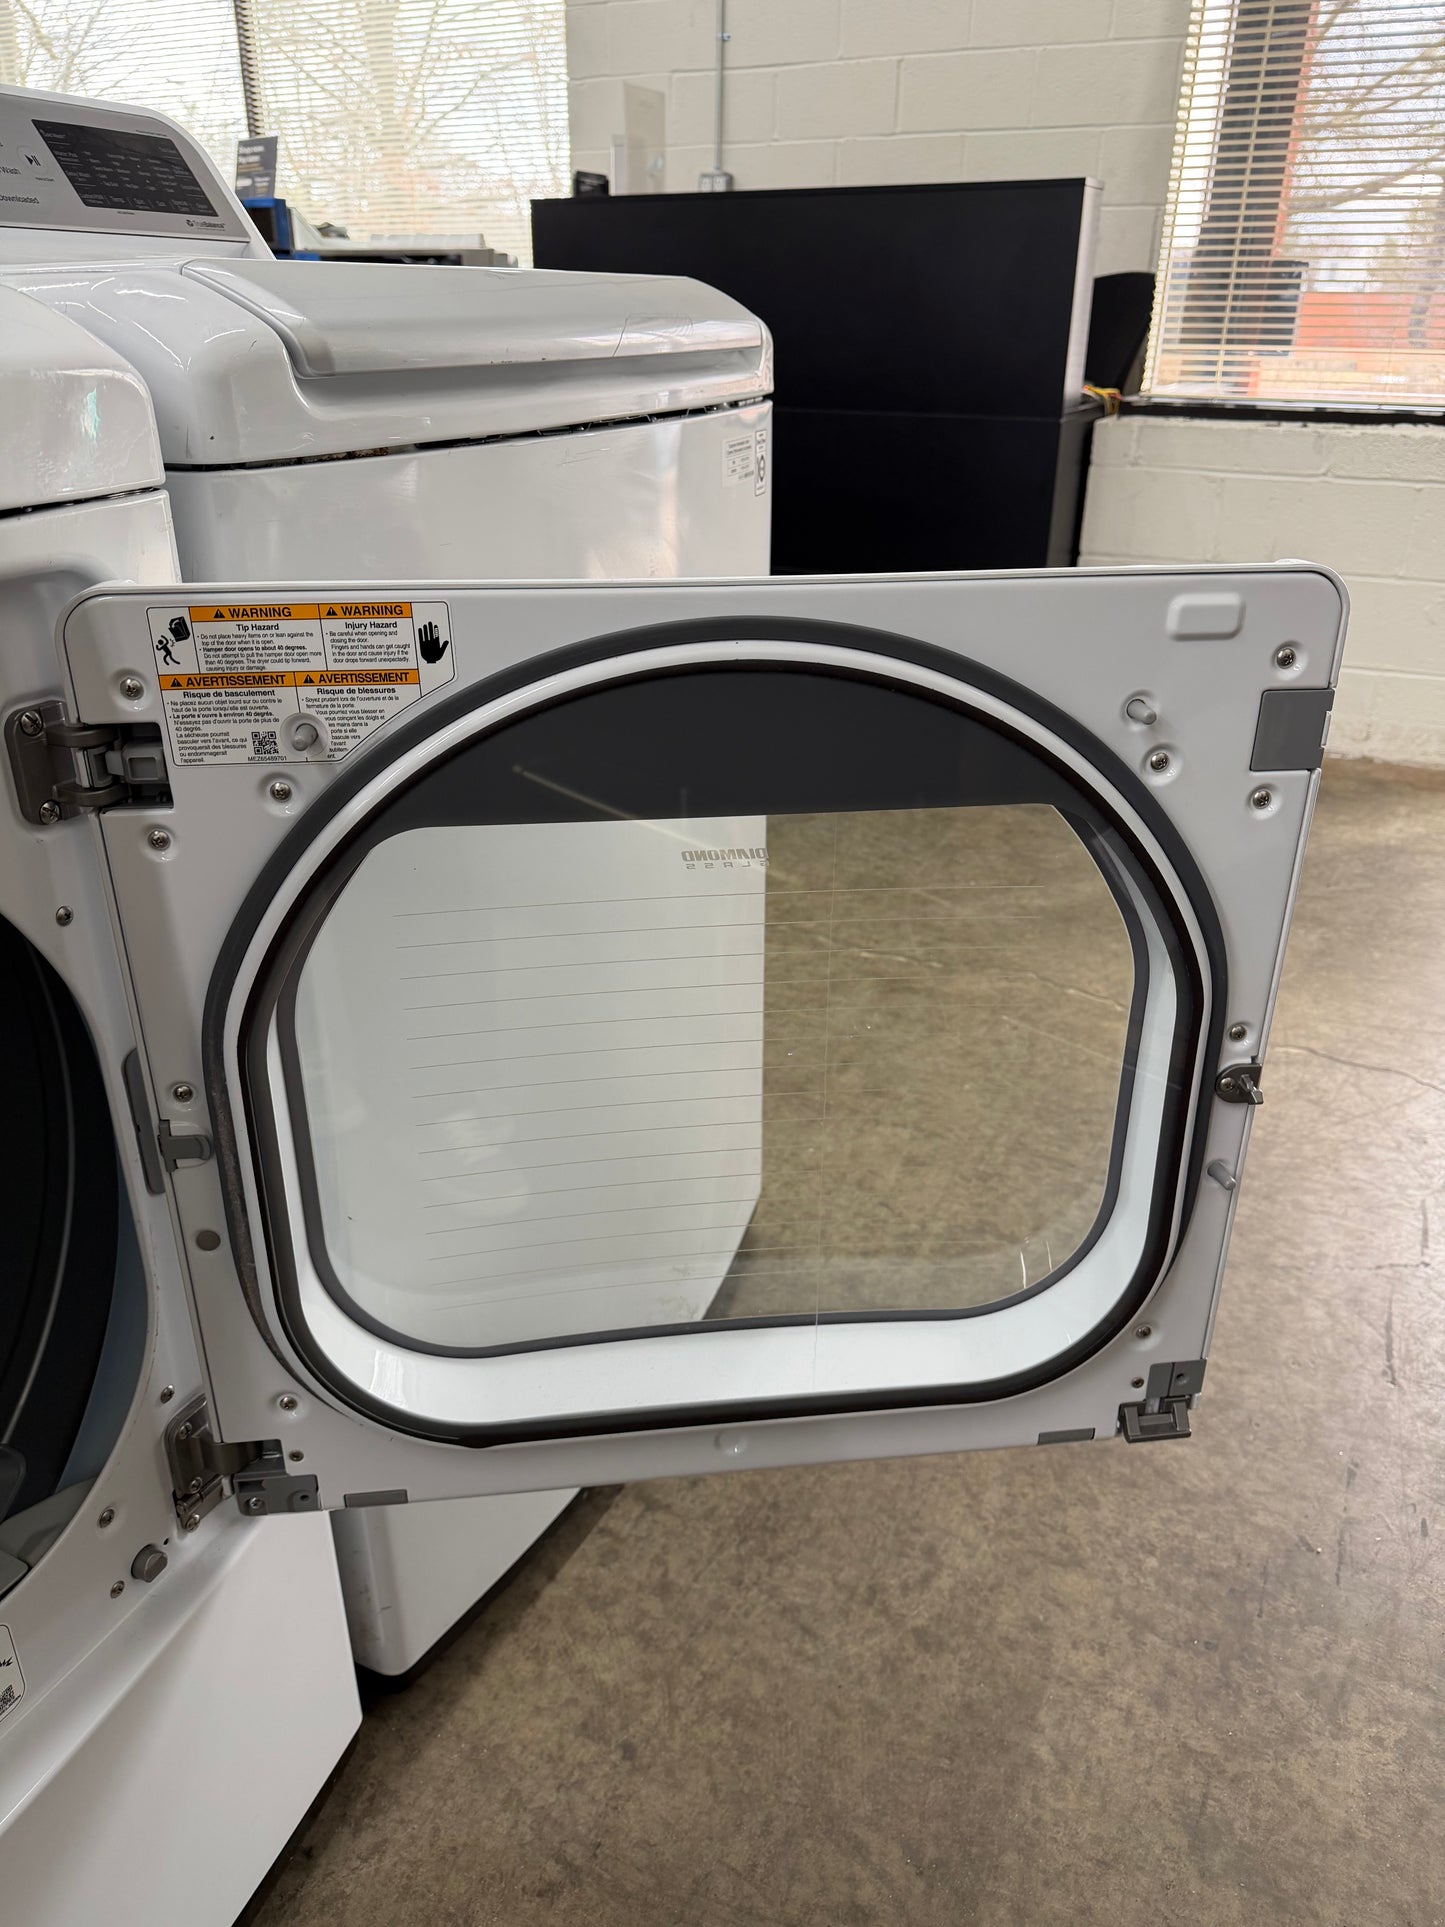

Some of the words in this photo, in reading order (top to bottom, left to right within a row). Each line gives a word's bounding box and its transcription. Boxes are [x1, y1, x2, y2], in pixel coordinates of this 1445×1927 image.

[228, 606, 292, 618] WARNING
[340, 604, 403, 616] WARNING
[236, 624, 250, 632] Tip
[251, 622, 280, 630] Hazard
[345, 622, 368, 630] Injury
[370, 621, 398, 629] Hazard
[186, 674, 286, 687] AVERTISSEMENT
[318, 672, 409, 684] AVERTISSEMENT
[183, 690, 211, 700] Risque
[224, 690, 276, 698] basculement
[317, 687, 345, 696] Risque
